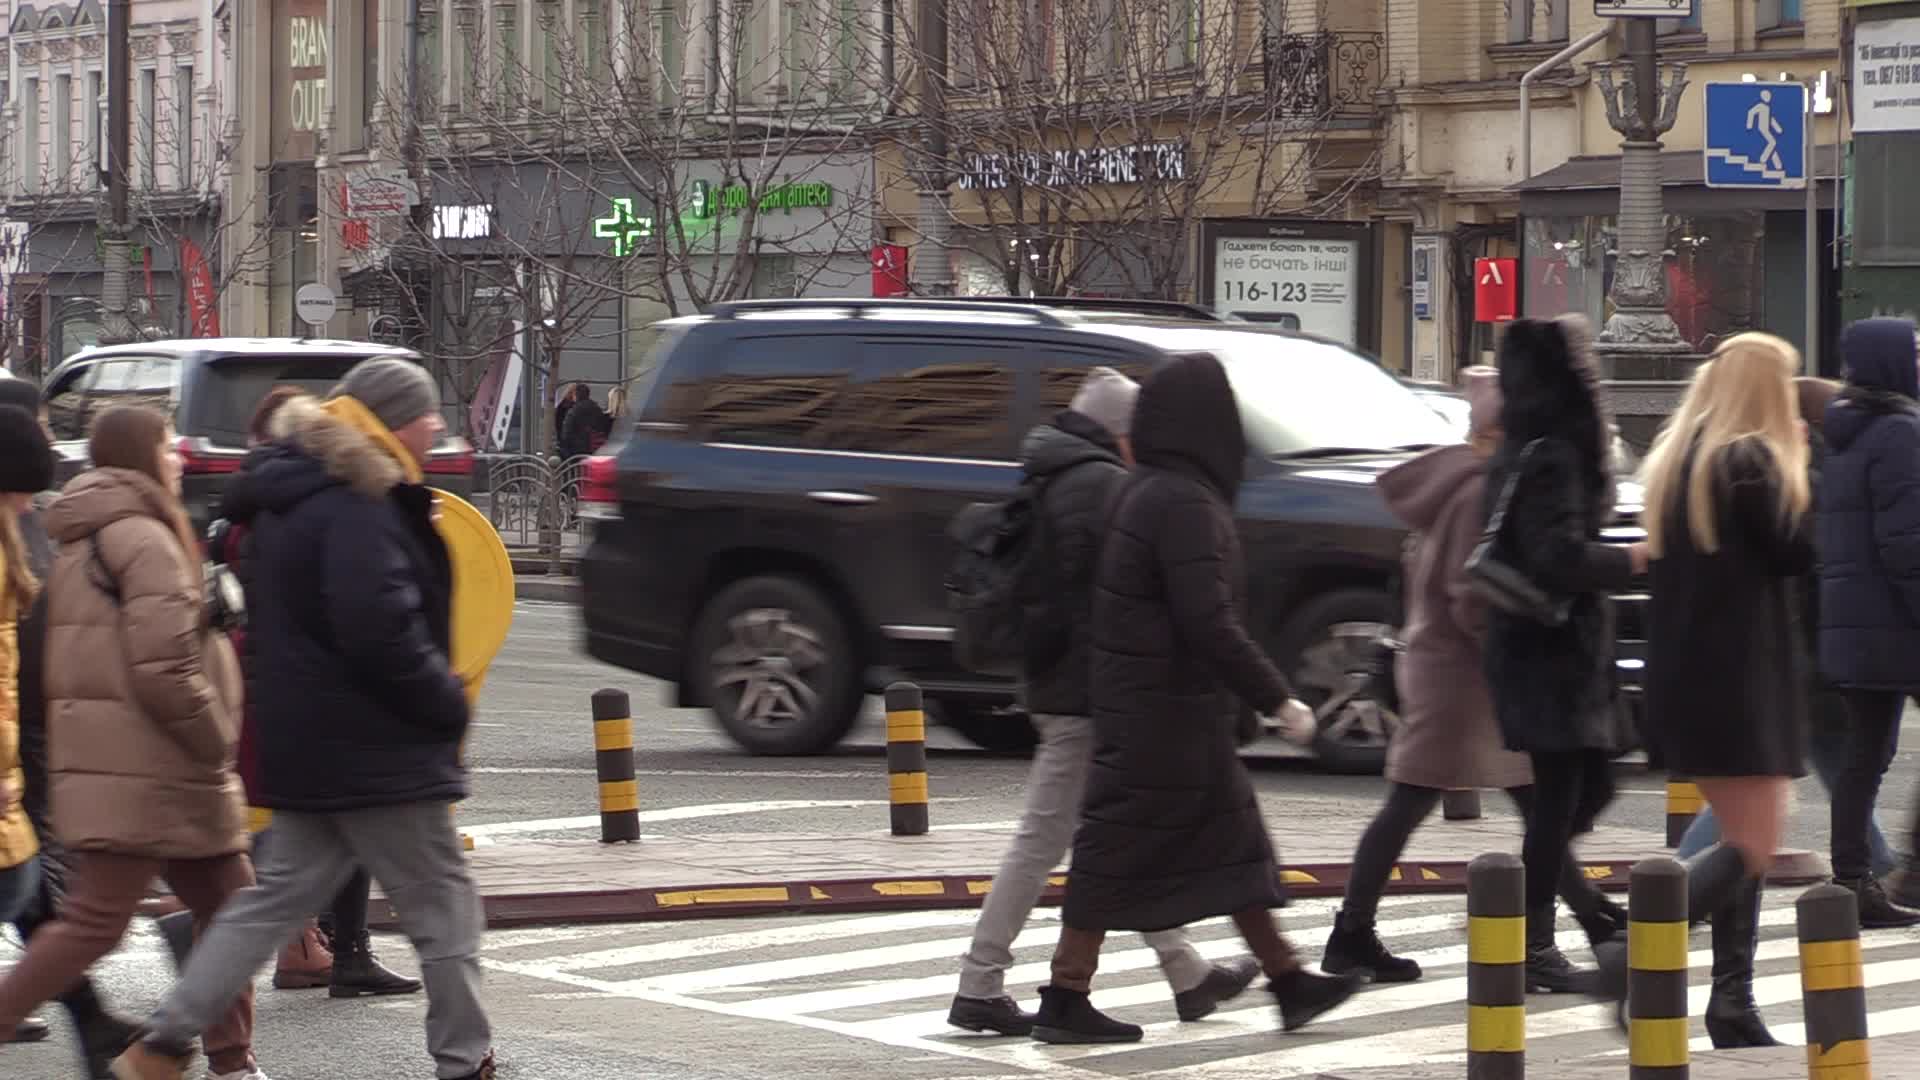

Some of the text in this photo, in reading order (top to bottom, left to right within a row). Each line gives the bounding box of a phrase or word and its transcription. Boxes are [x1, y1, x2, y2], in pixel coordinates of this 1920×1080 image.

[1098, 144, 1185, 183] BENEON
[1223, 254, 1347, 272] не бачать інші
[1224, 280, 1308, 303] 116-123
